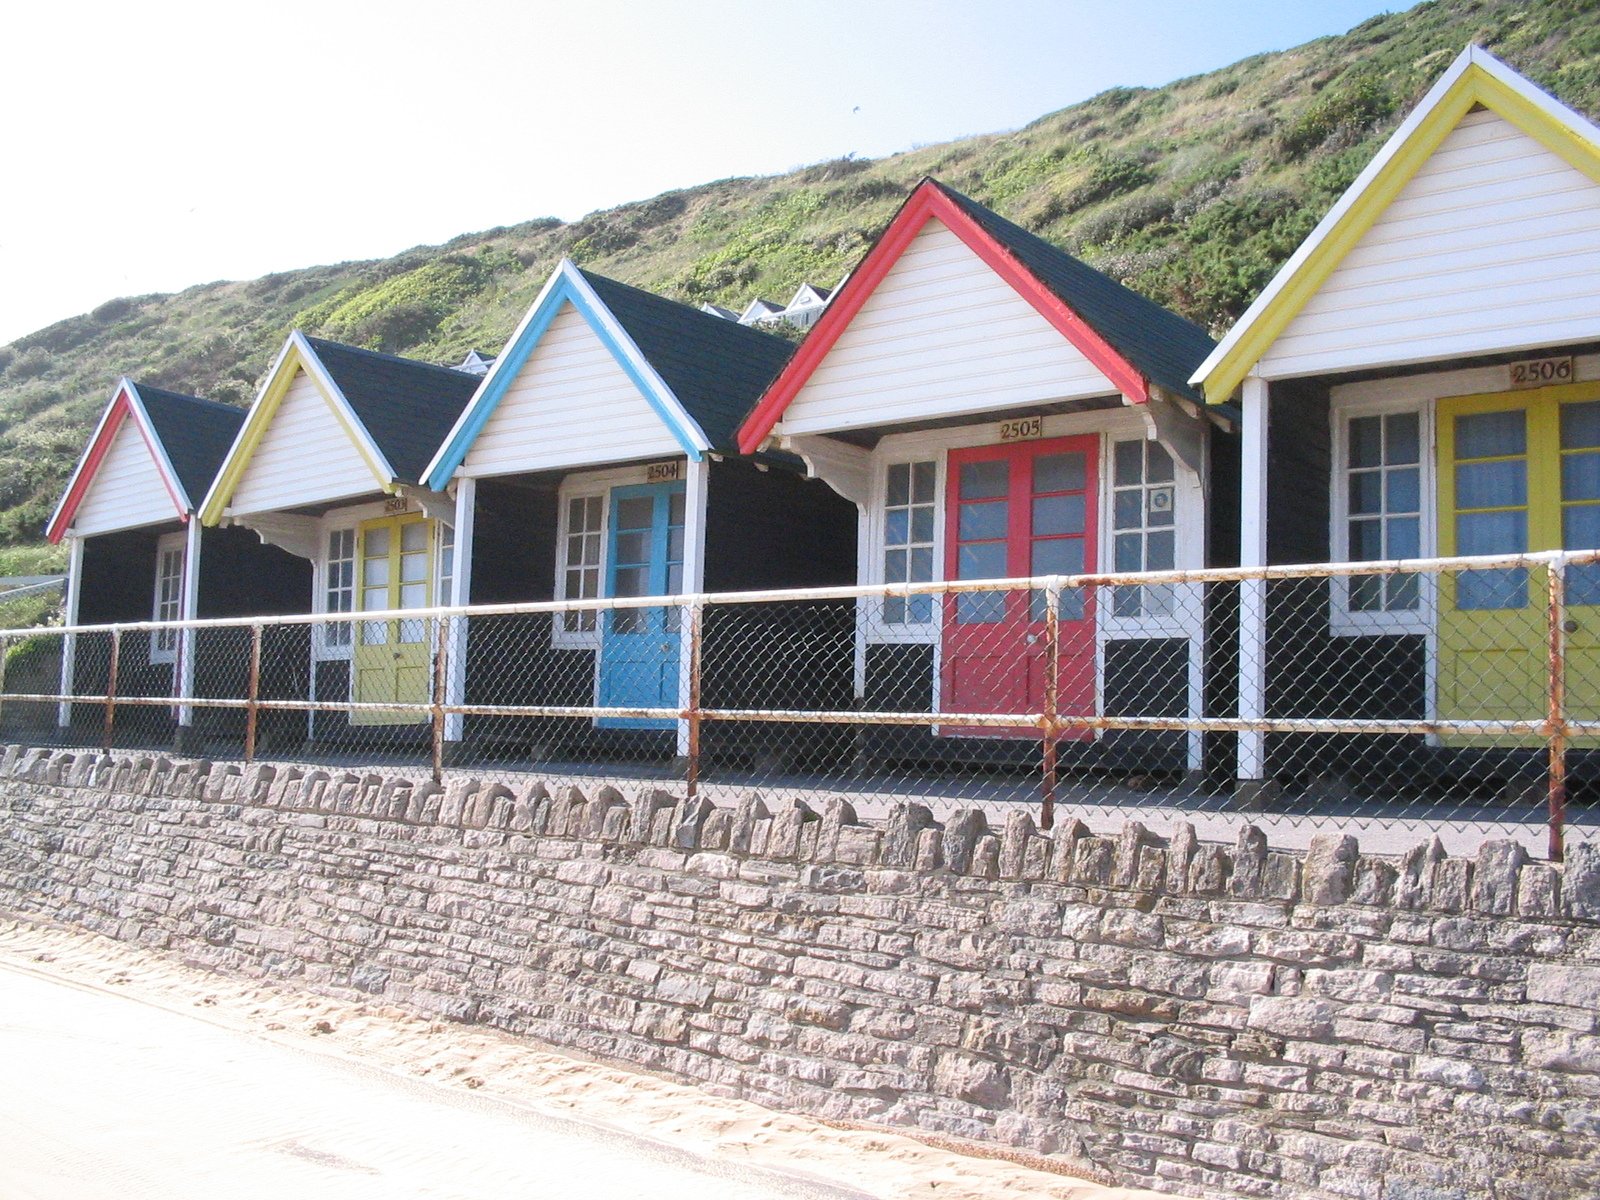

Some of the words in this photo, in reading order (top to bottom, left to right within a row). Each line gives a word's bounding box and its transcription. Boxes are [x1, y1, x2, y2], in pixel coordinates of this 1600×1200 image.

[1513, 360, 1571, 383] 2506
[1001, 420, 1040, 439] 2505
[648, 464, 675, 479] 2504
